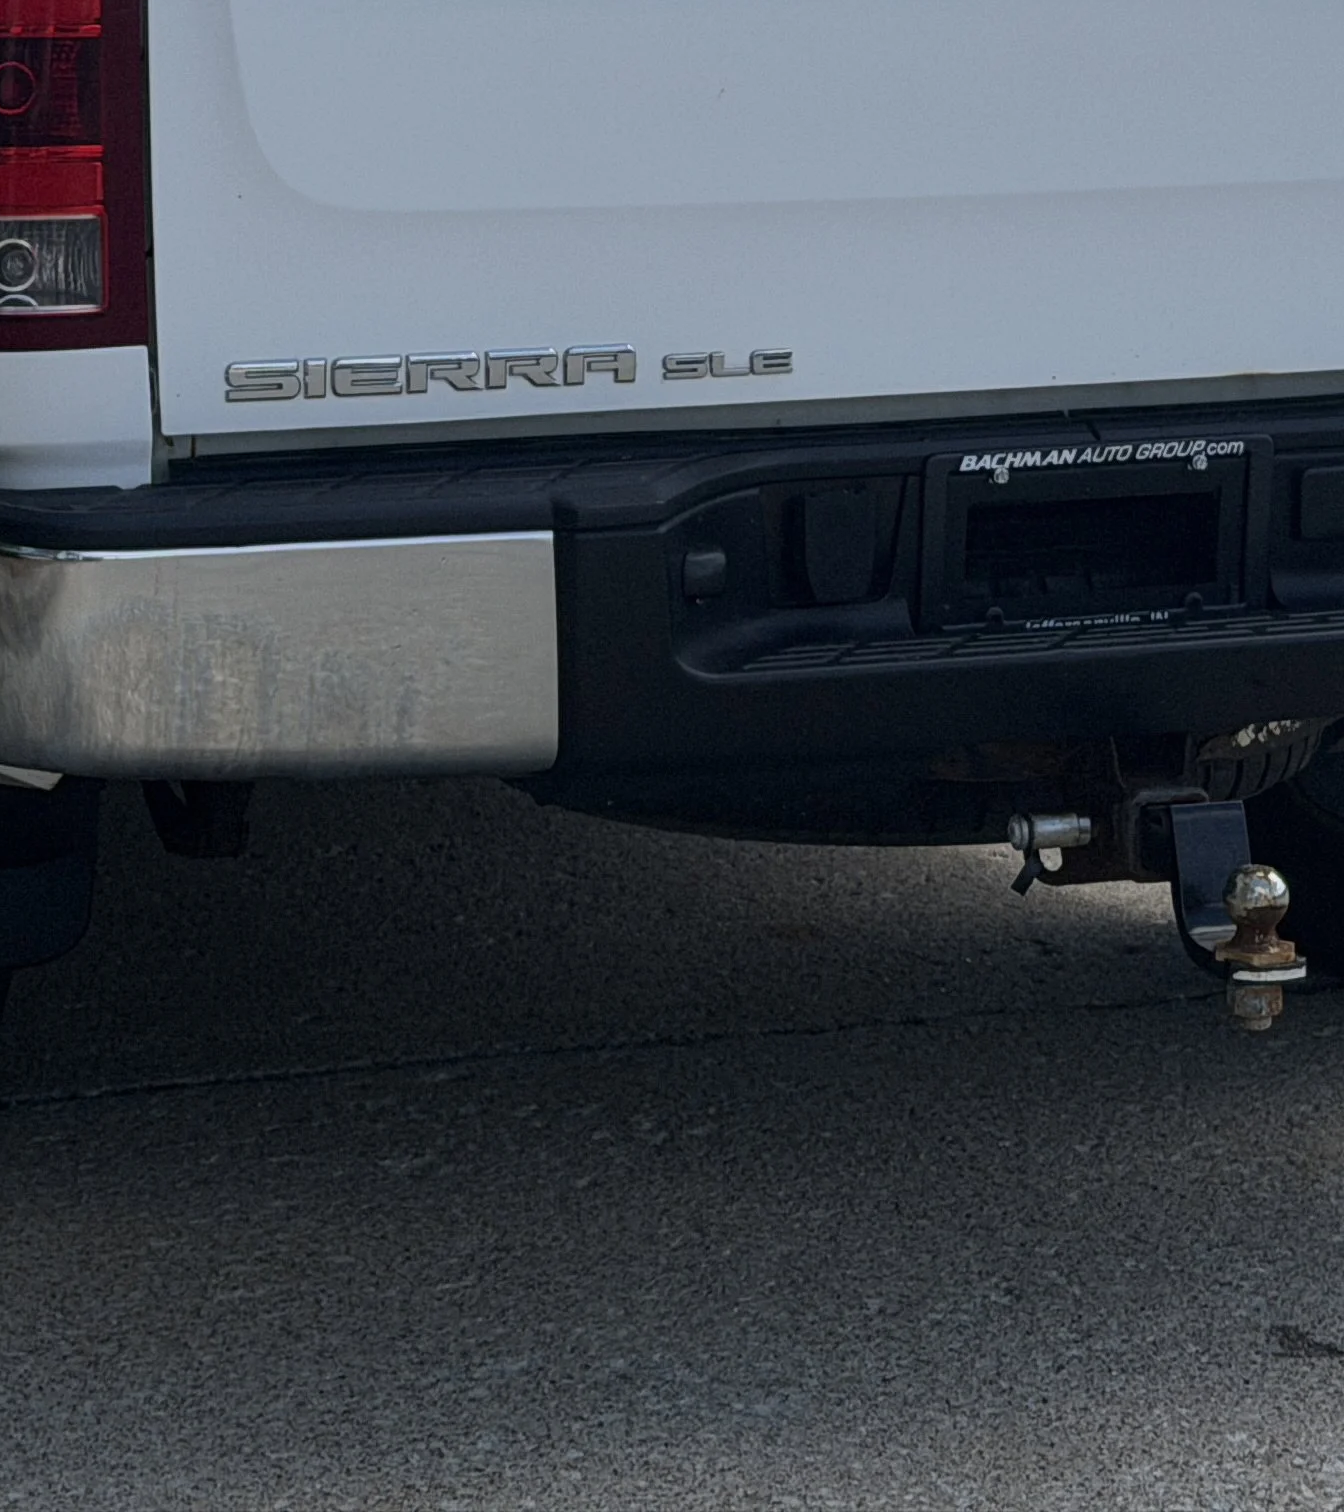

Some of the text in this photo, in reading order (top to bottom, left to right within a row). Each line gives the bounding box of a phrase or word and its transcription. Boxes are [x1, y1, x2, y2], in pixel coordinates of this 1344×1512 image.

[224, 343, 794, 403] SIERRA SLE
[959, 448, 1078, 472] BACHMAN
[1078, 444, 1132, 463] AUTO
